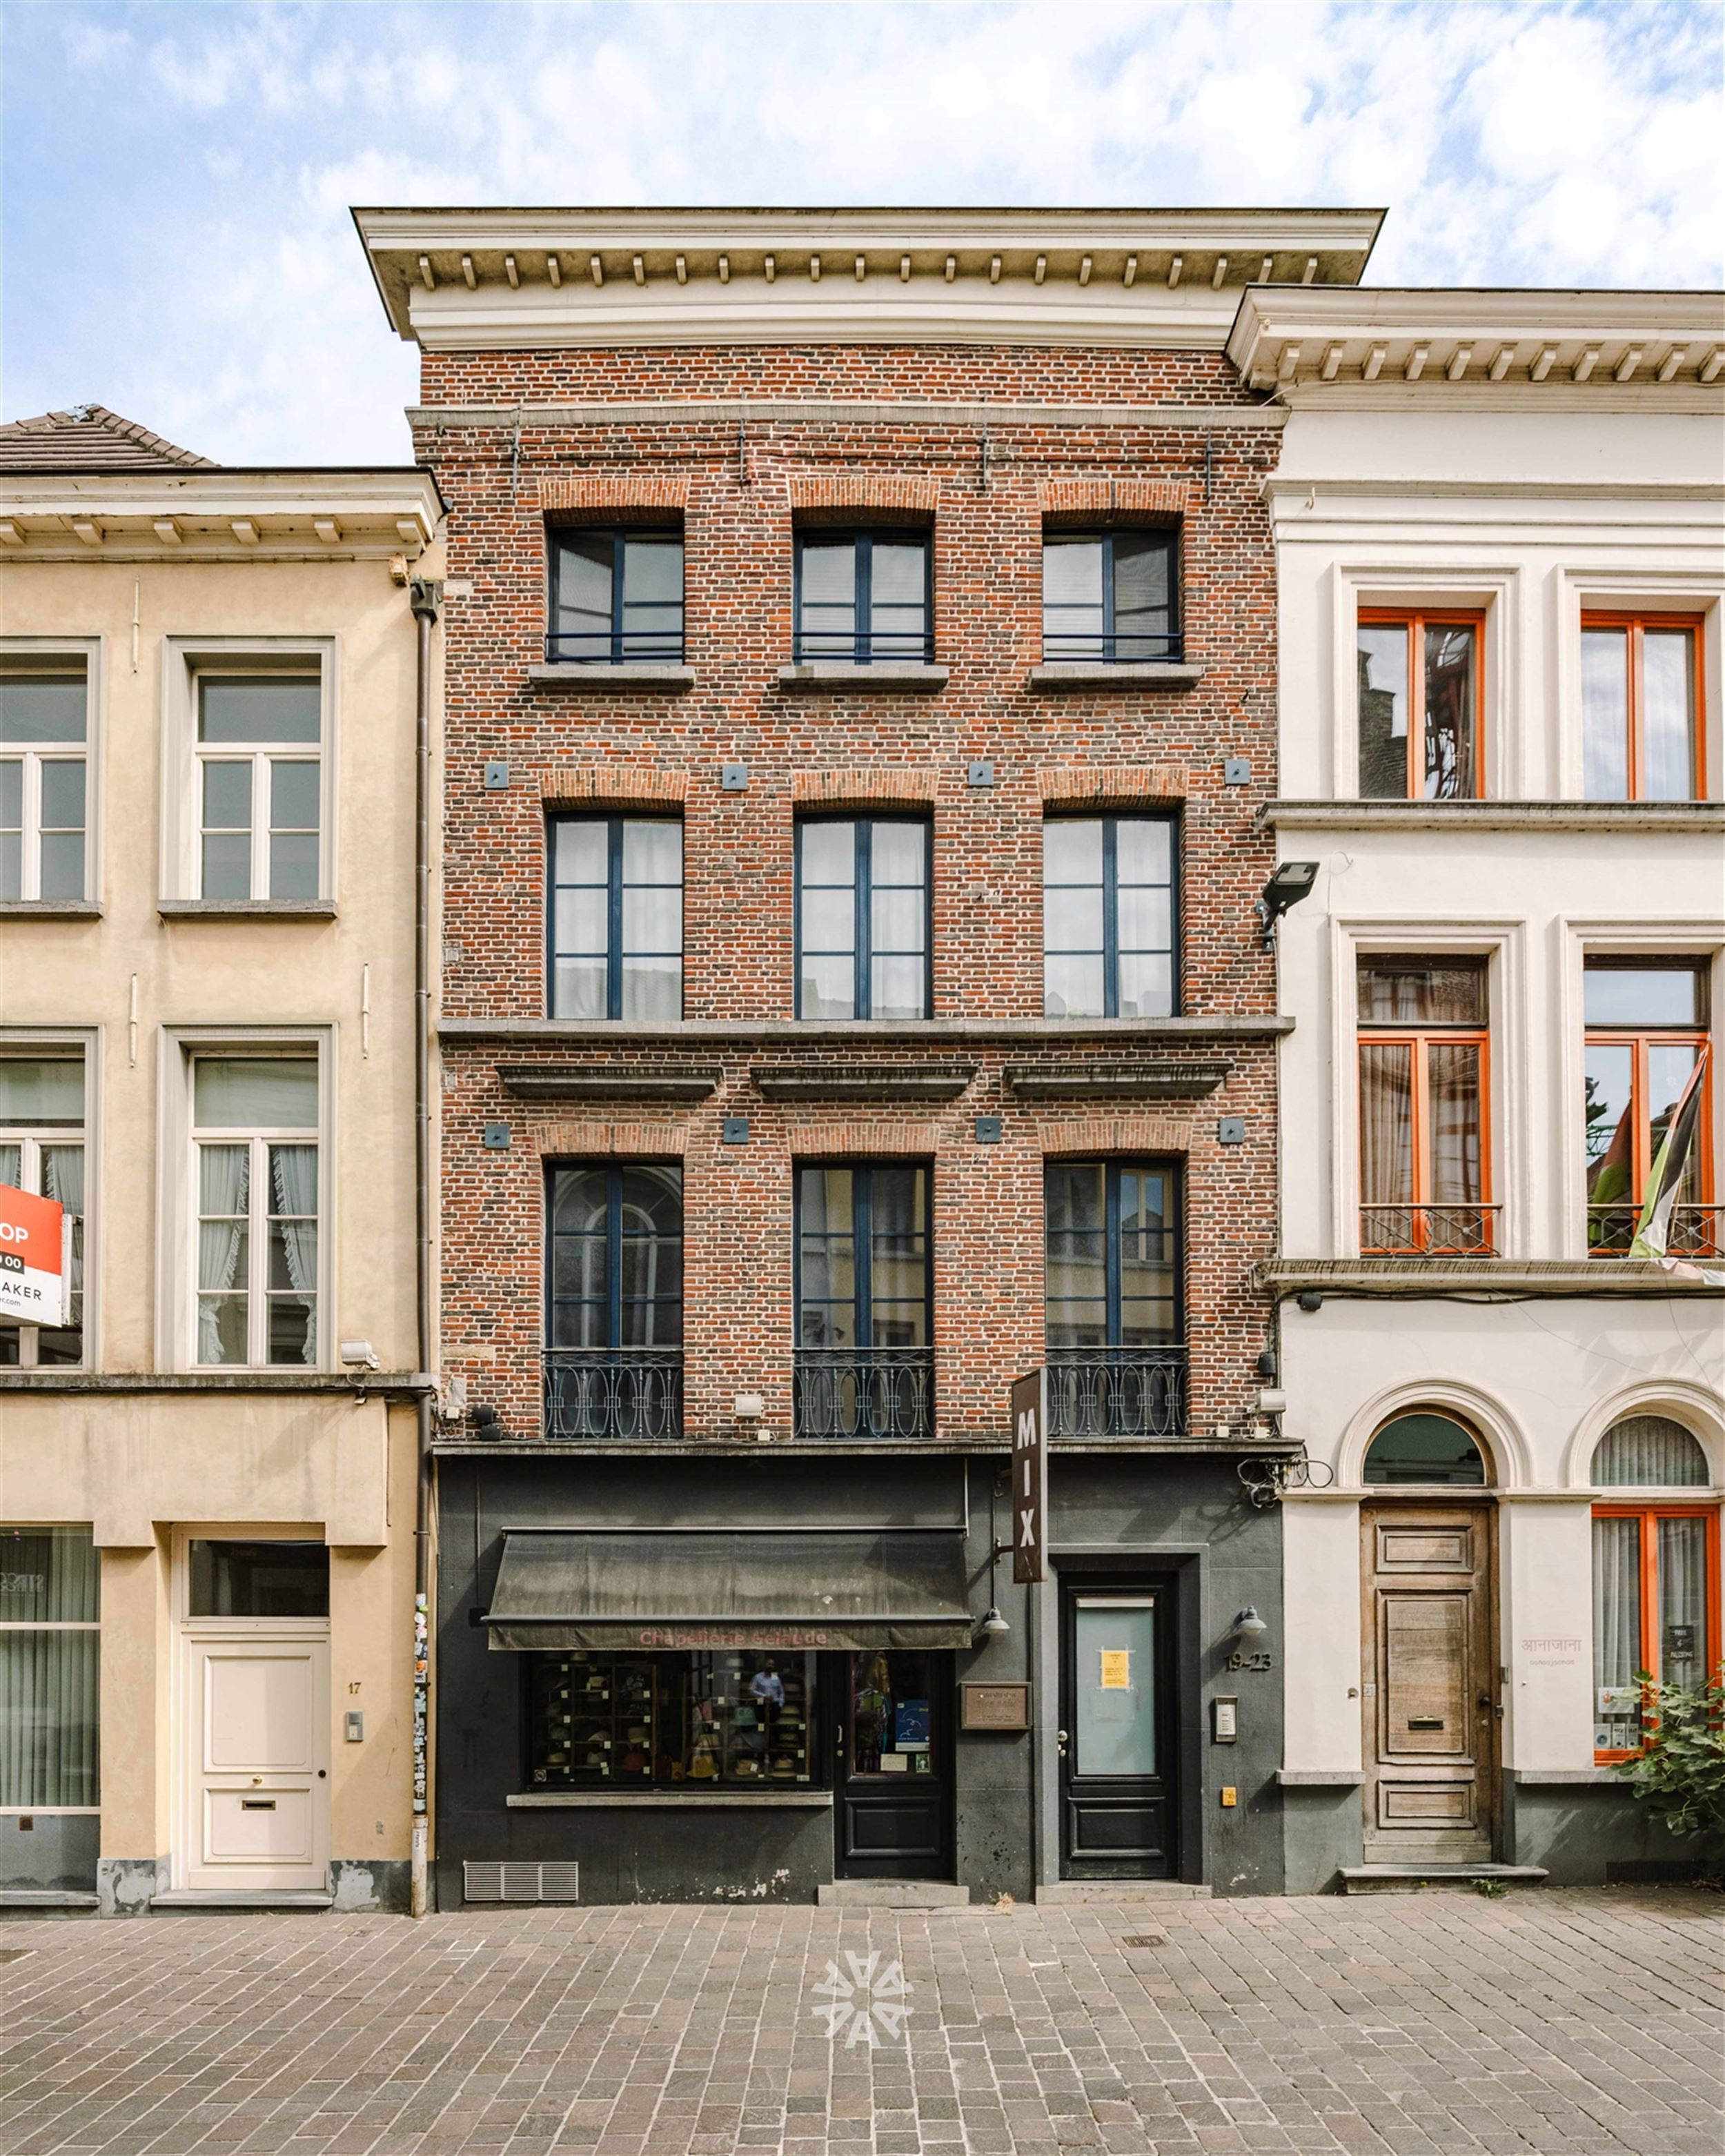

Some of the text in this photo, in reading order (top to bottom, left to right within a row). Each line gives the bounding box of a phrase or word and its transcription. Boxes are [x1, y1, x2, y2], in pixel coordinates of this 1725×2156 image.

[5, 1256, 21, 1269] 00
[2, 1282, 42, 1301] AKER
[1017, 1407, 1037, 1547] MIX
[1224, 1652, 1272, 1672] 19-23
[348, 1682, 362, 1694] 17
